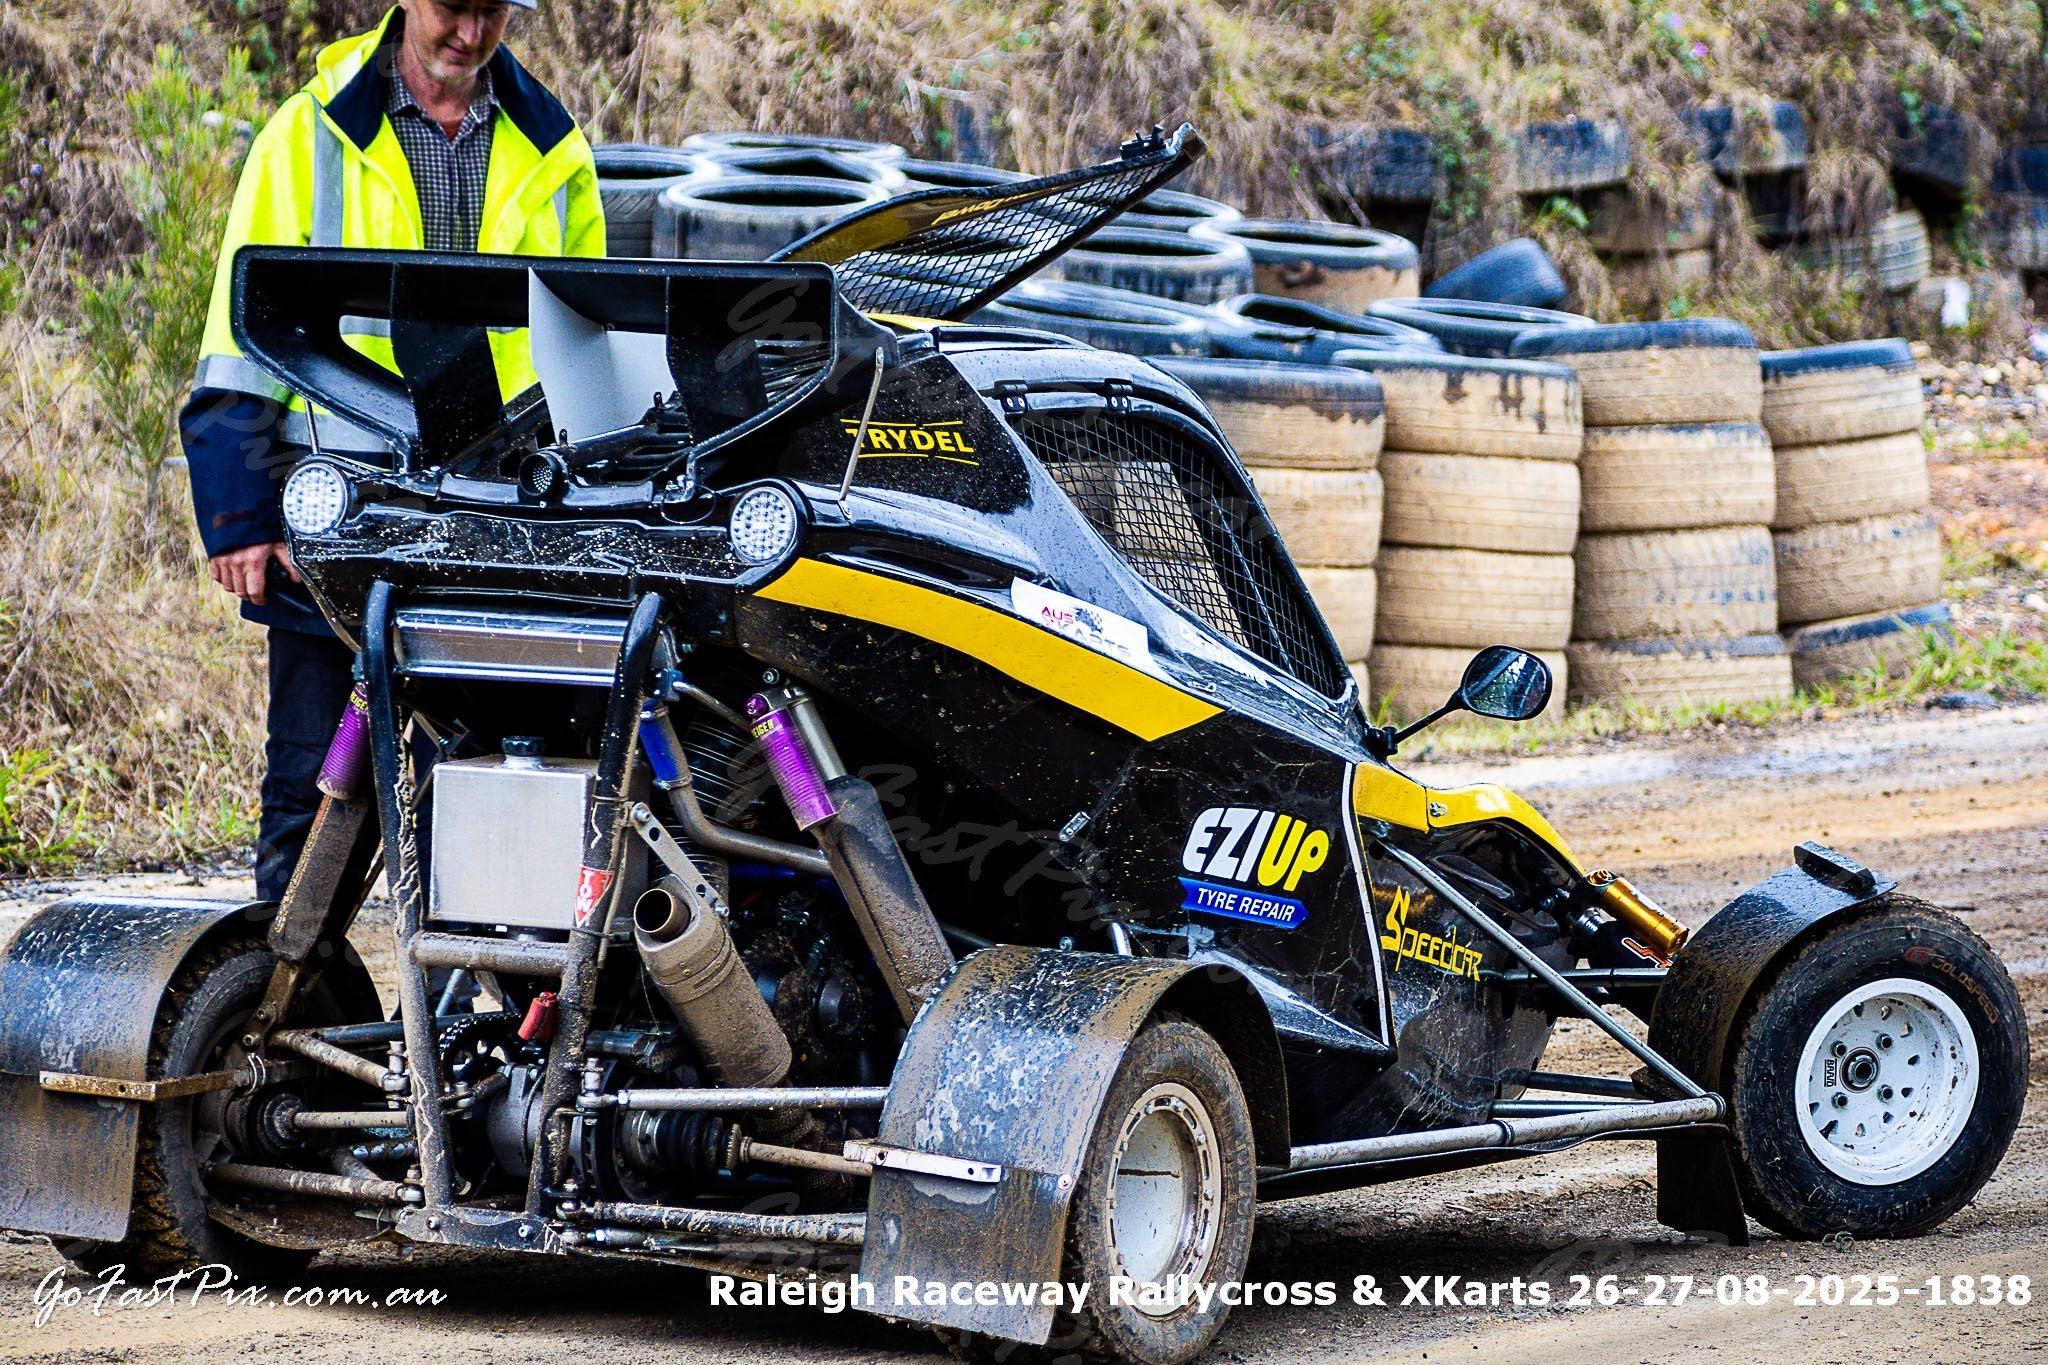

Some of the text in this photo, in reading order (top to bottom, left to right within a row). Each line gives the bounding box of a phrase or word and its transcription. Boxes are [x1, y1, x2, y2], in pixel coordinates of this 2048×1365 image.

[1041, 605, 1075, 626] AUS
[576, 869, 596, 913] TOW
[1196, 887, 1296, 922] TYRE REPAIR
